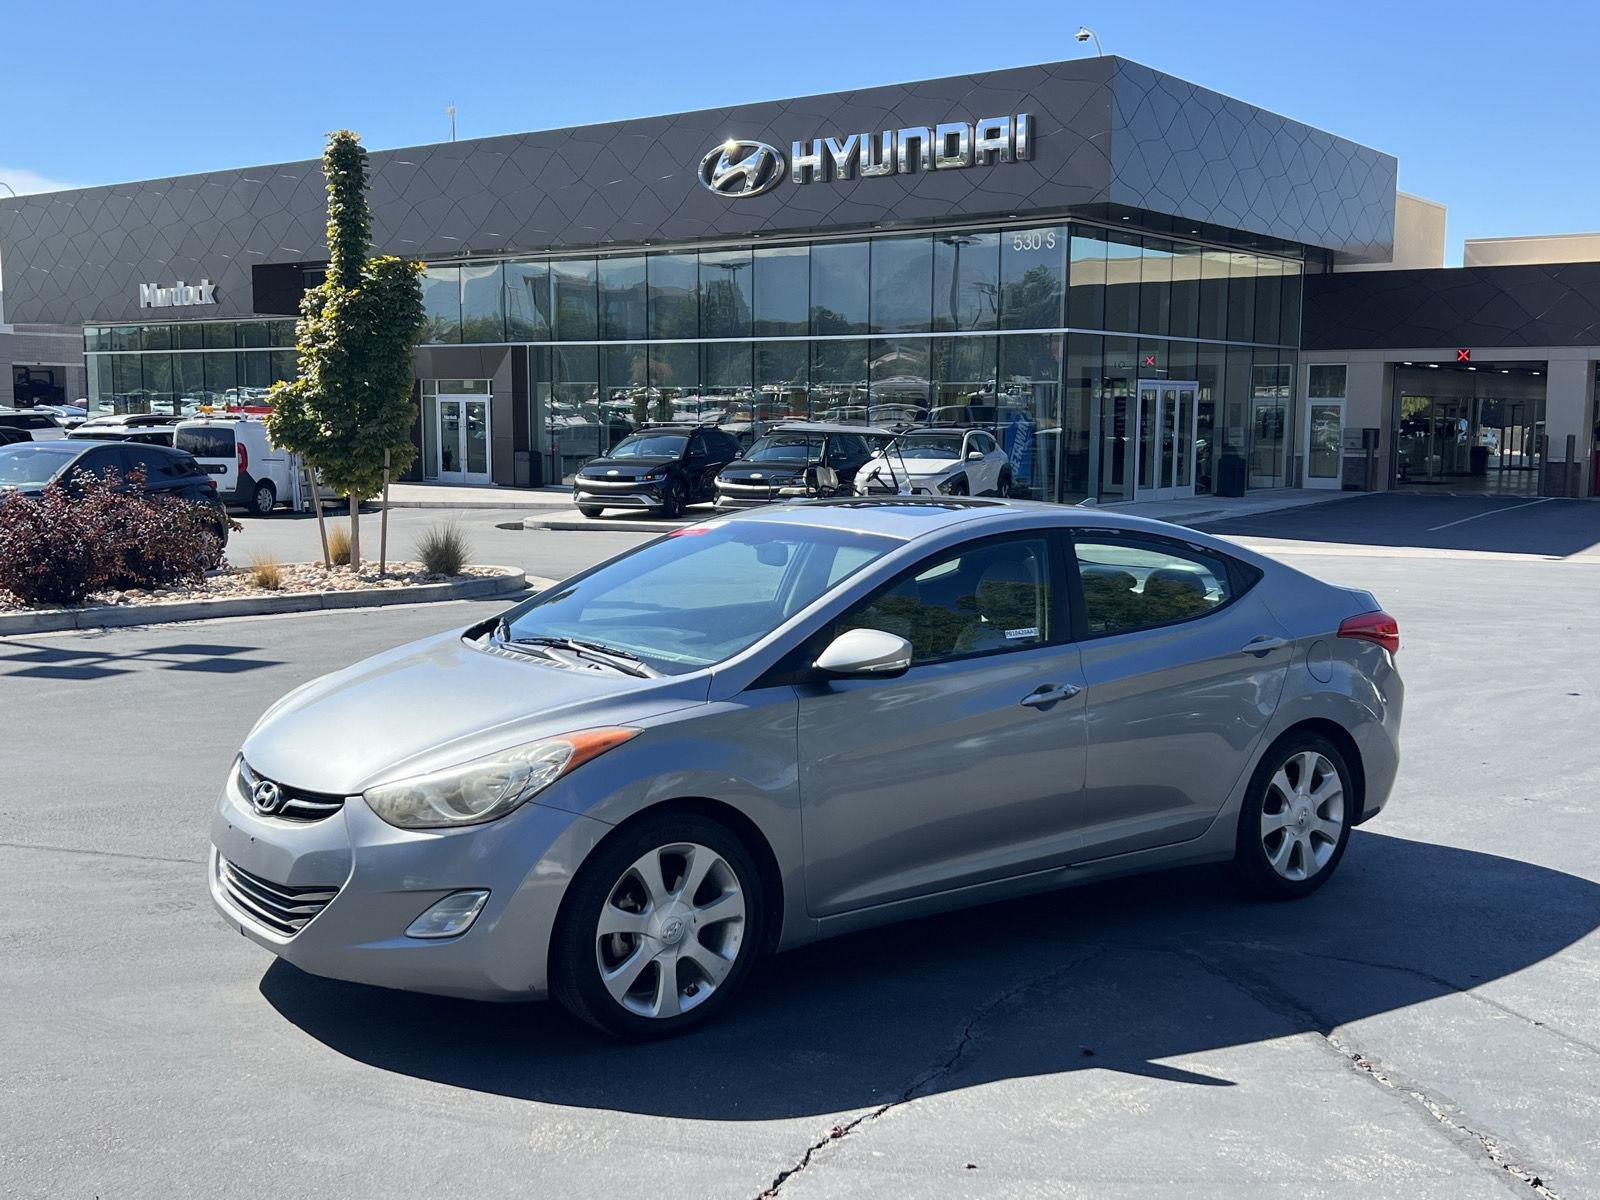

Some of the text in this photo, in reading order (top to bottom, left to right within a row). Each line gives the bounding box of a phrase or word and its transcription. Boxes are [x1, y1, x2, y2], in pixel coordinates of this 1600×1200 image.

[791, 112, 1034, 185] HYUNDAI
[1013, 232, 1055, 251] 530 S
[139, 279, 217, 308] Murdock
